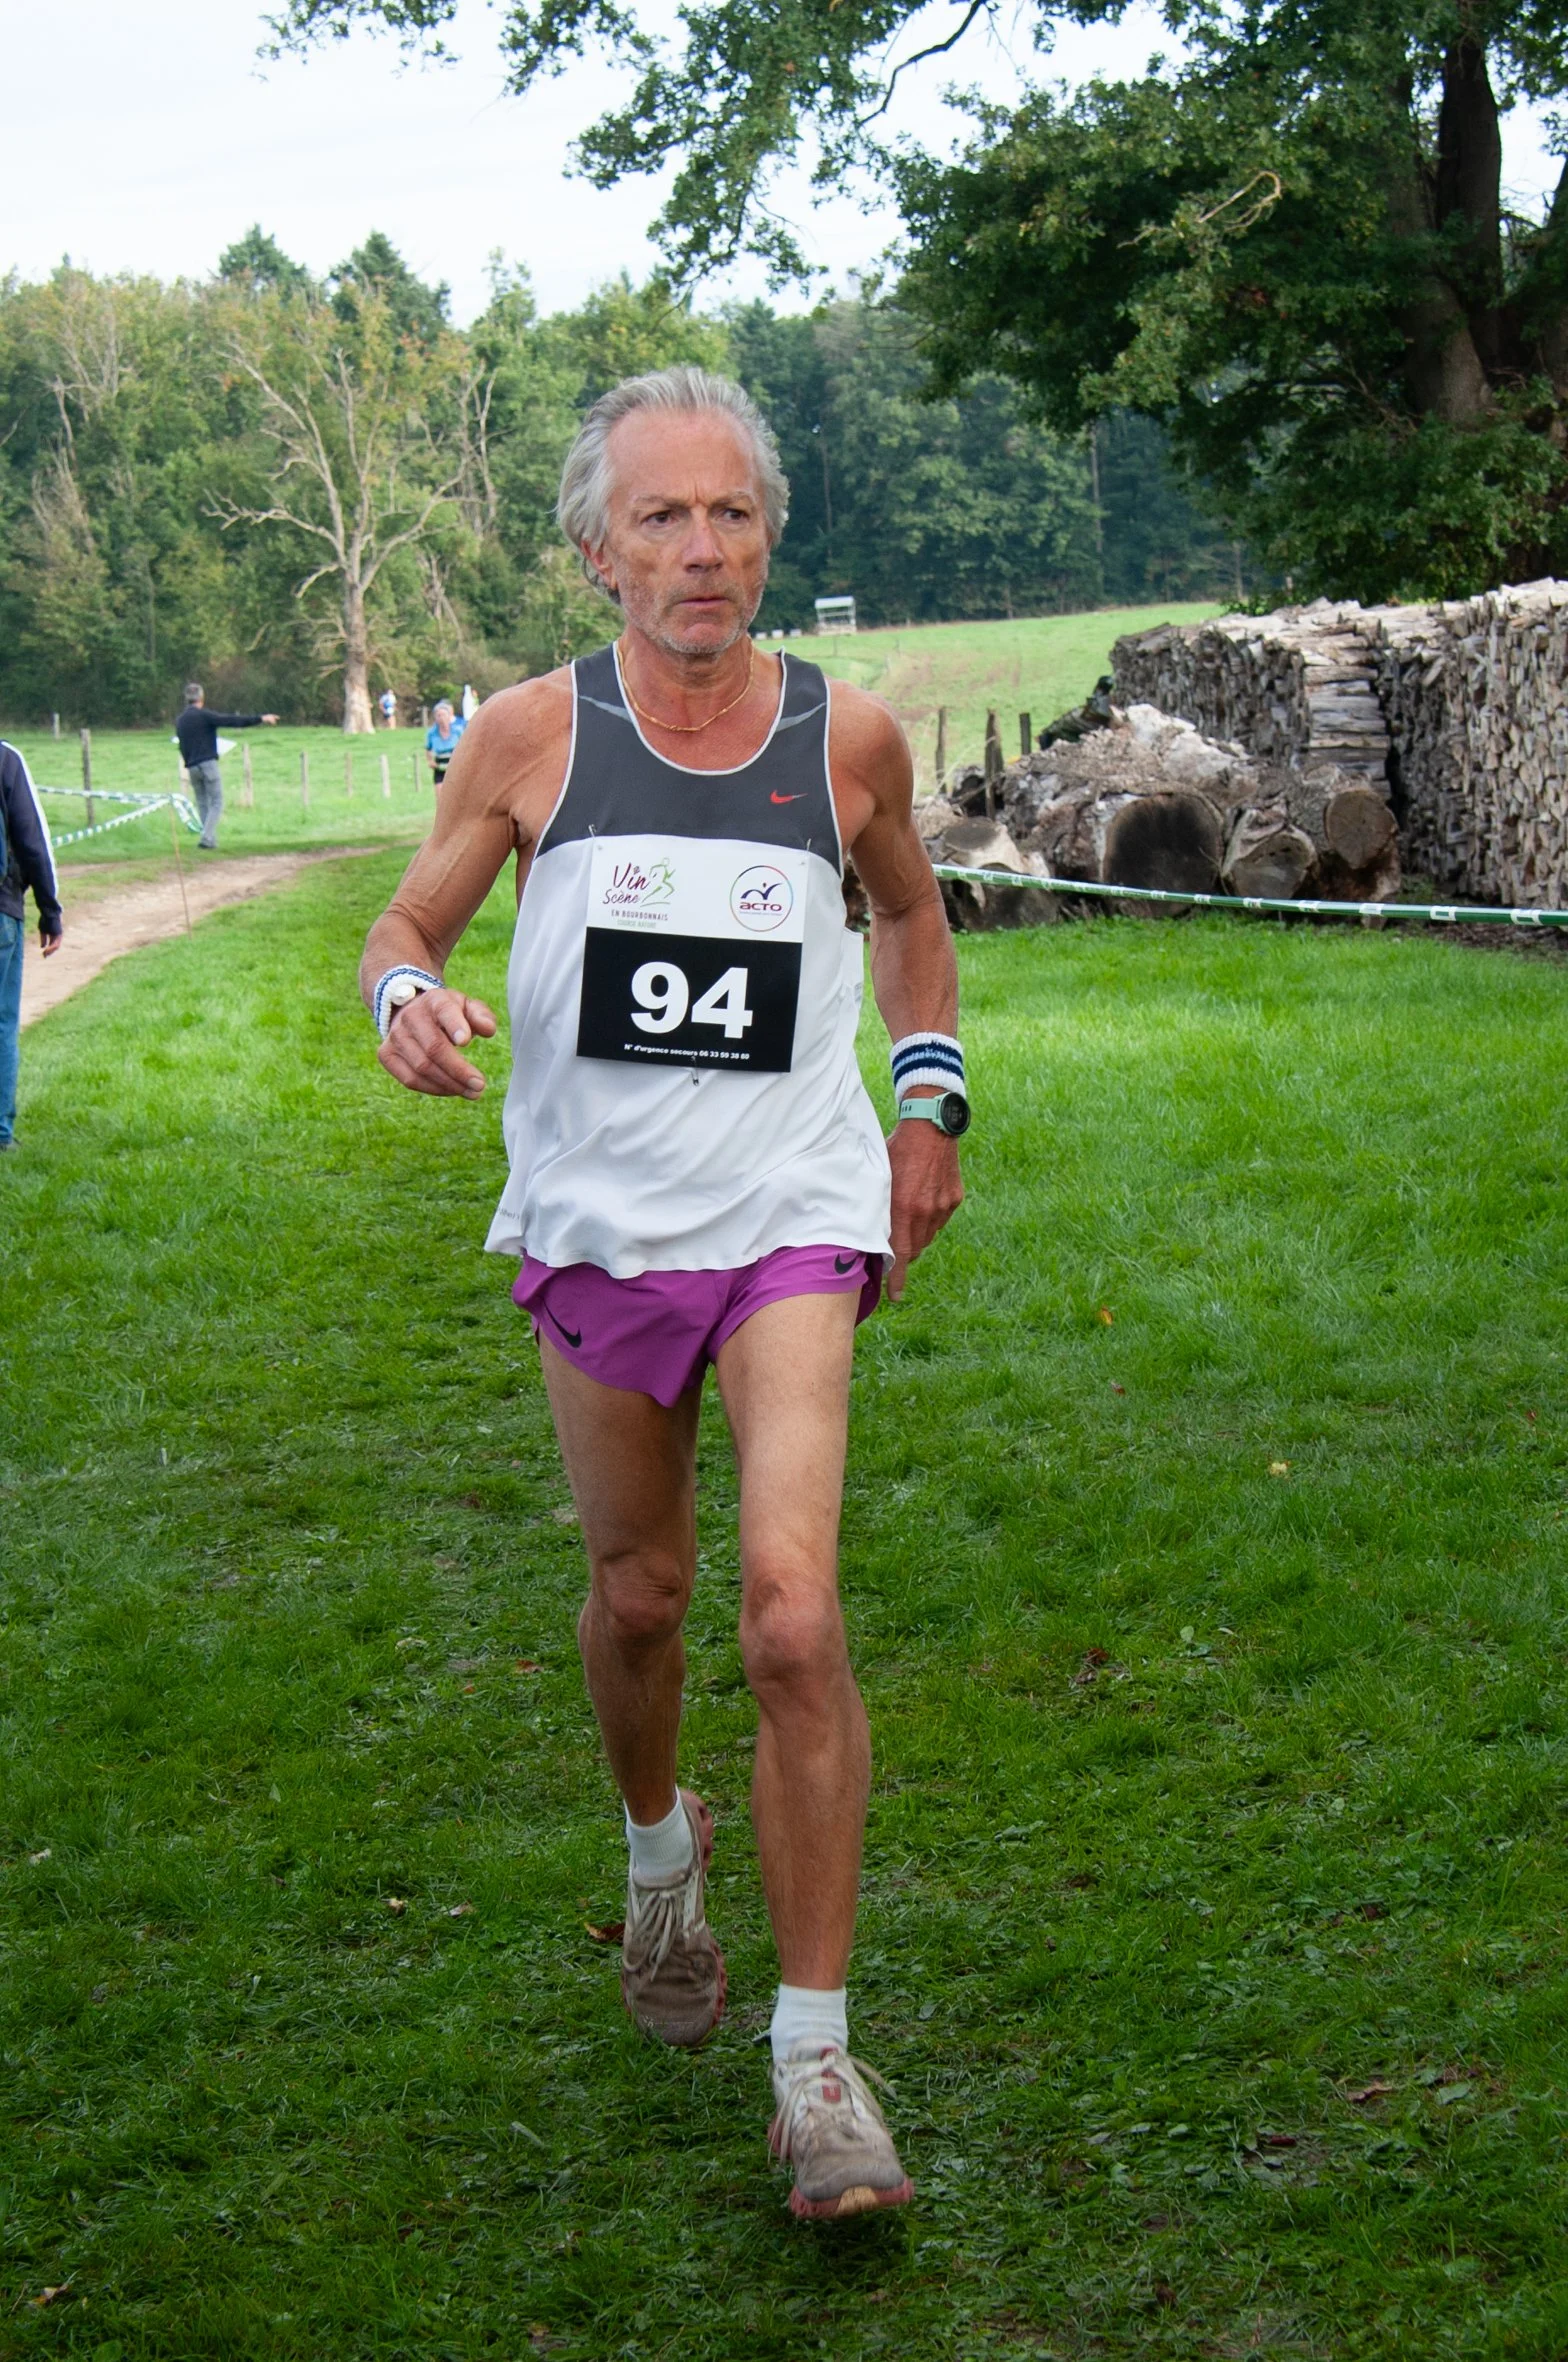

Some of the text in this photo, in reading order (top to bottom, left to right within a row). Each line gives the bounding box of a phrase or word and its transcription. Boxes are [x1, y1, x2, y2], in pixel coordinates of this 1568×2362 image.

[611, 909, 669, 921] EN BOURBONNAIS
[630, 961, 753, 1039] 94
